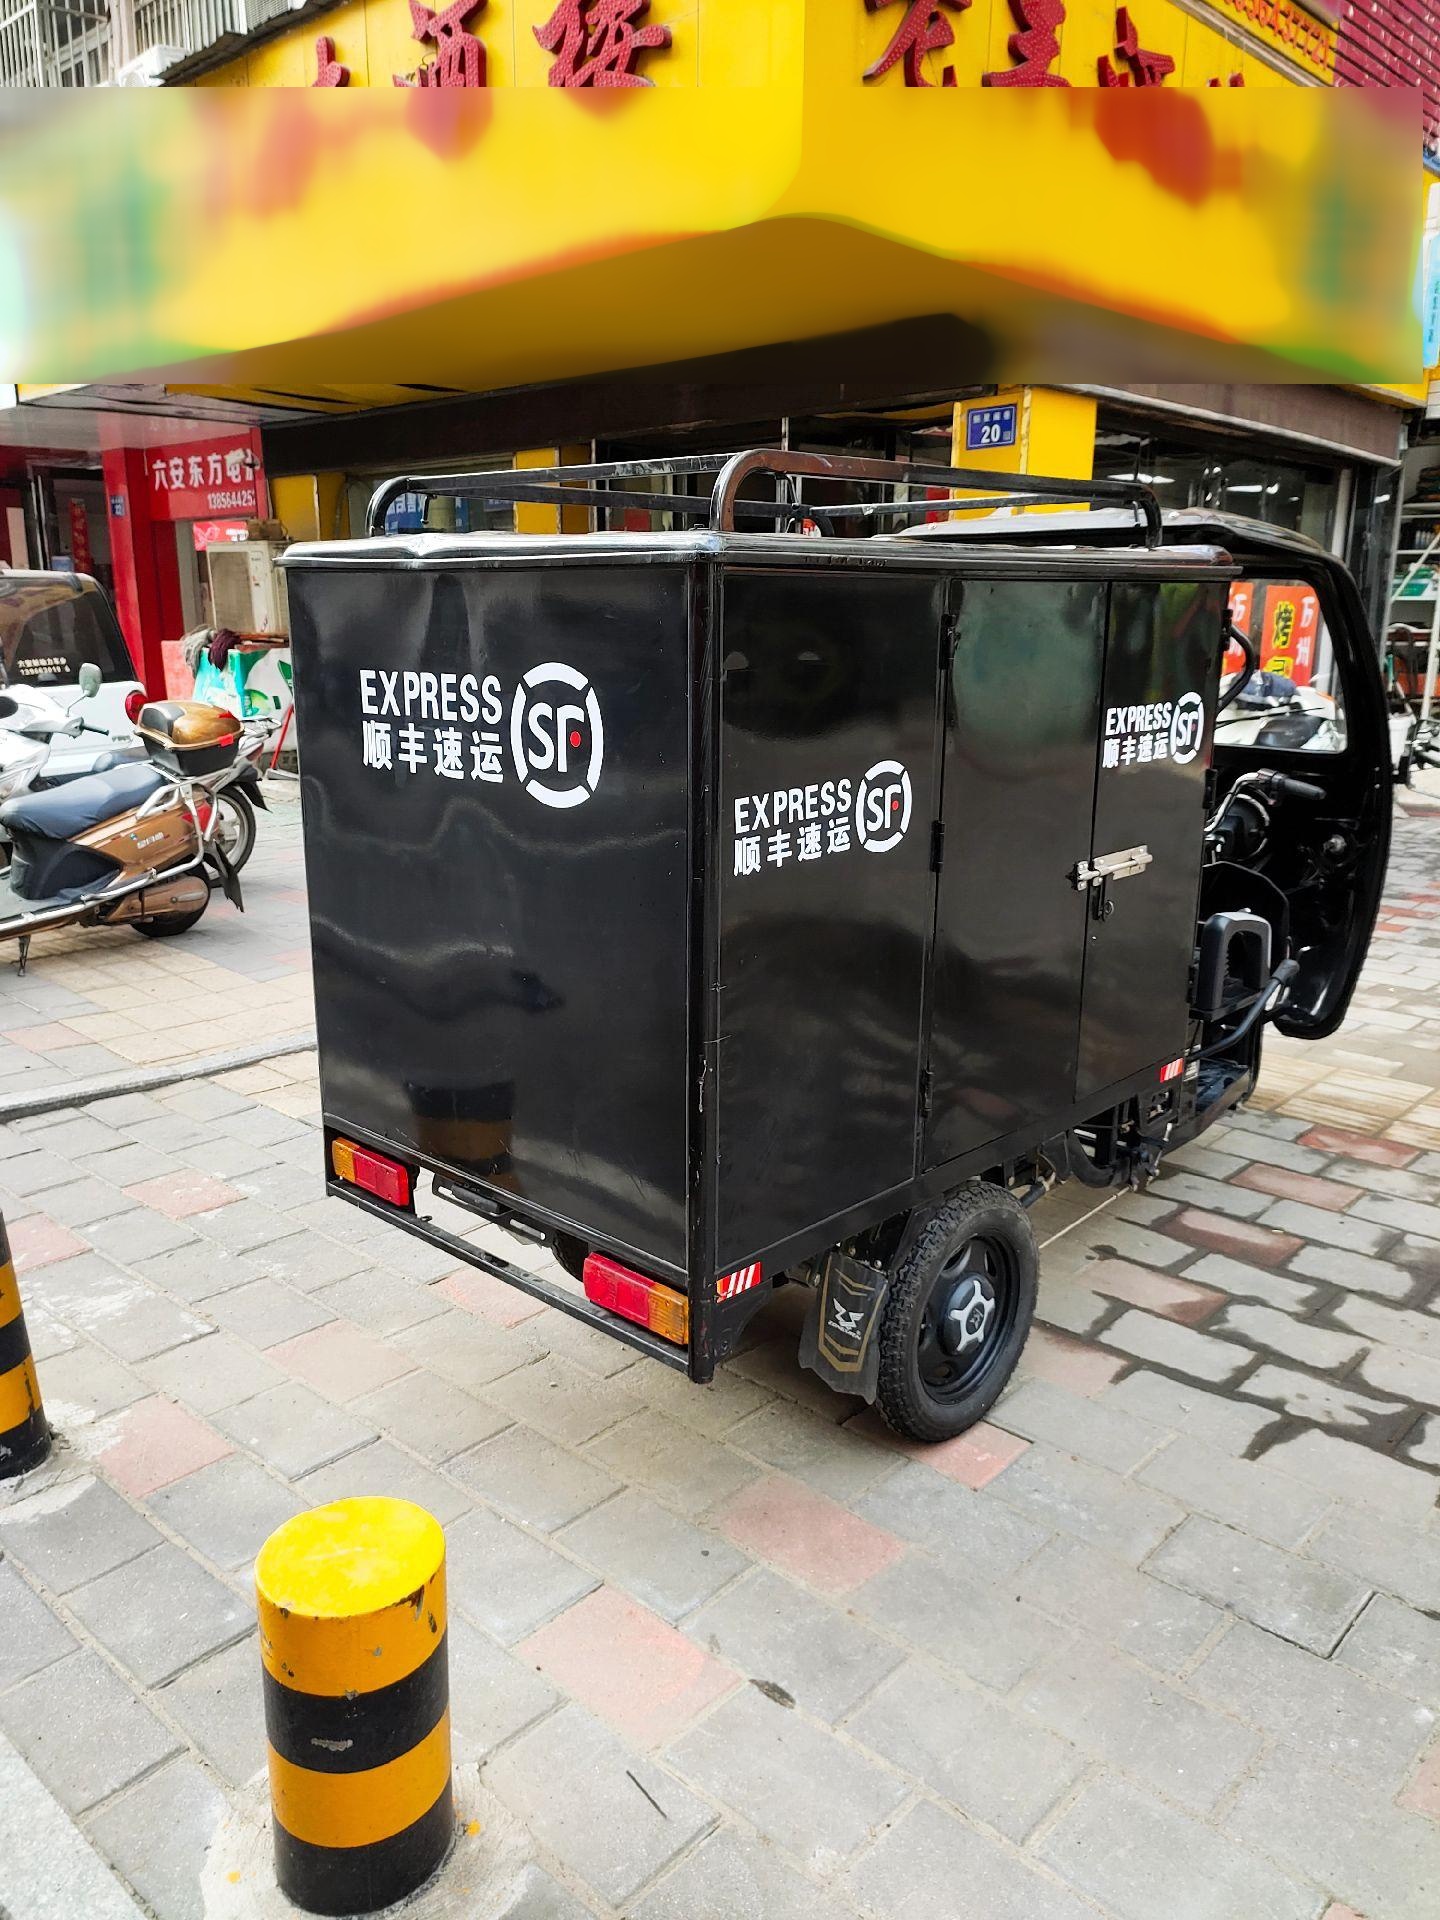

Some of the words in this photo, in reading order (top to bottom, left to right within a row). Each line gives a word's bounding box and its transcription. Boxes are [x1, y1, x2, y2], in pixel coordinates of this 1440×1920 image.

[981, 424, 1001, 444] 20
[359, 669, 503, 725] EXPRESS
[1105, 701, 1172, 736] EXPRESS
[362, 720, 504, 784] 顺丰速运
[1102, 731, 1169, 769] 顺丰速运
[734, 778, 852, 835] EXPRESS
[733, 816, 851, 877] 顺丰速运
